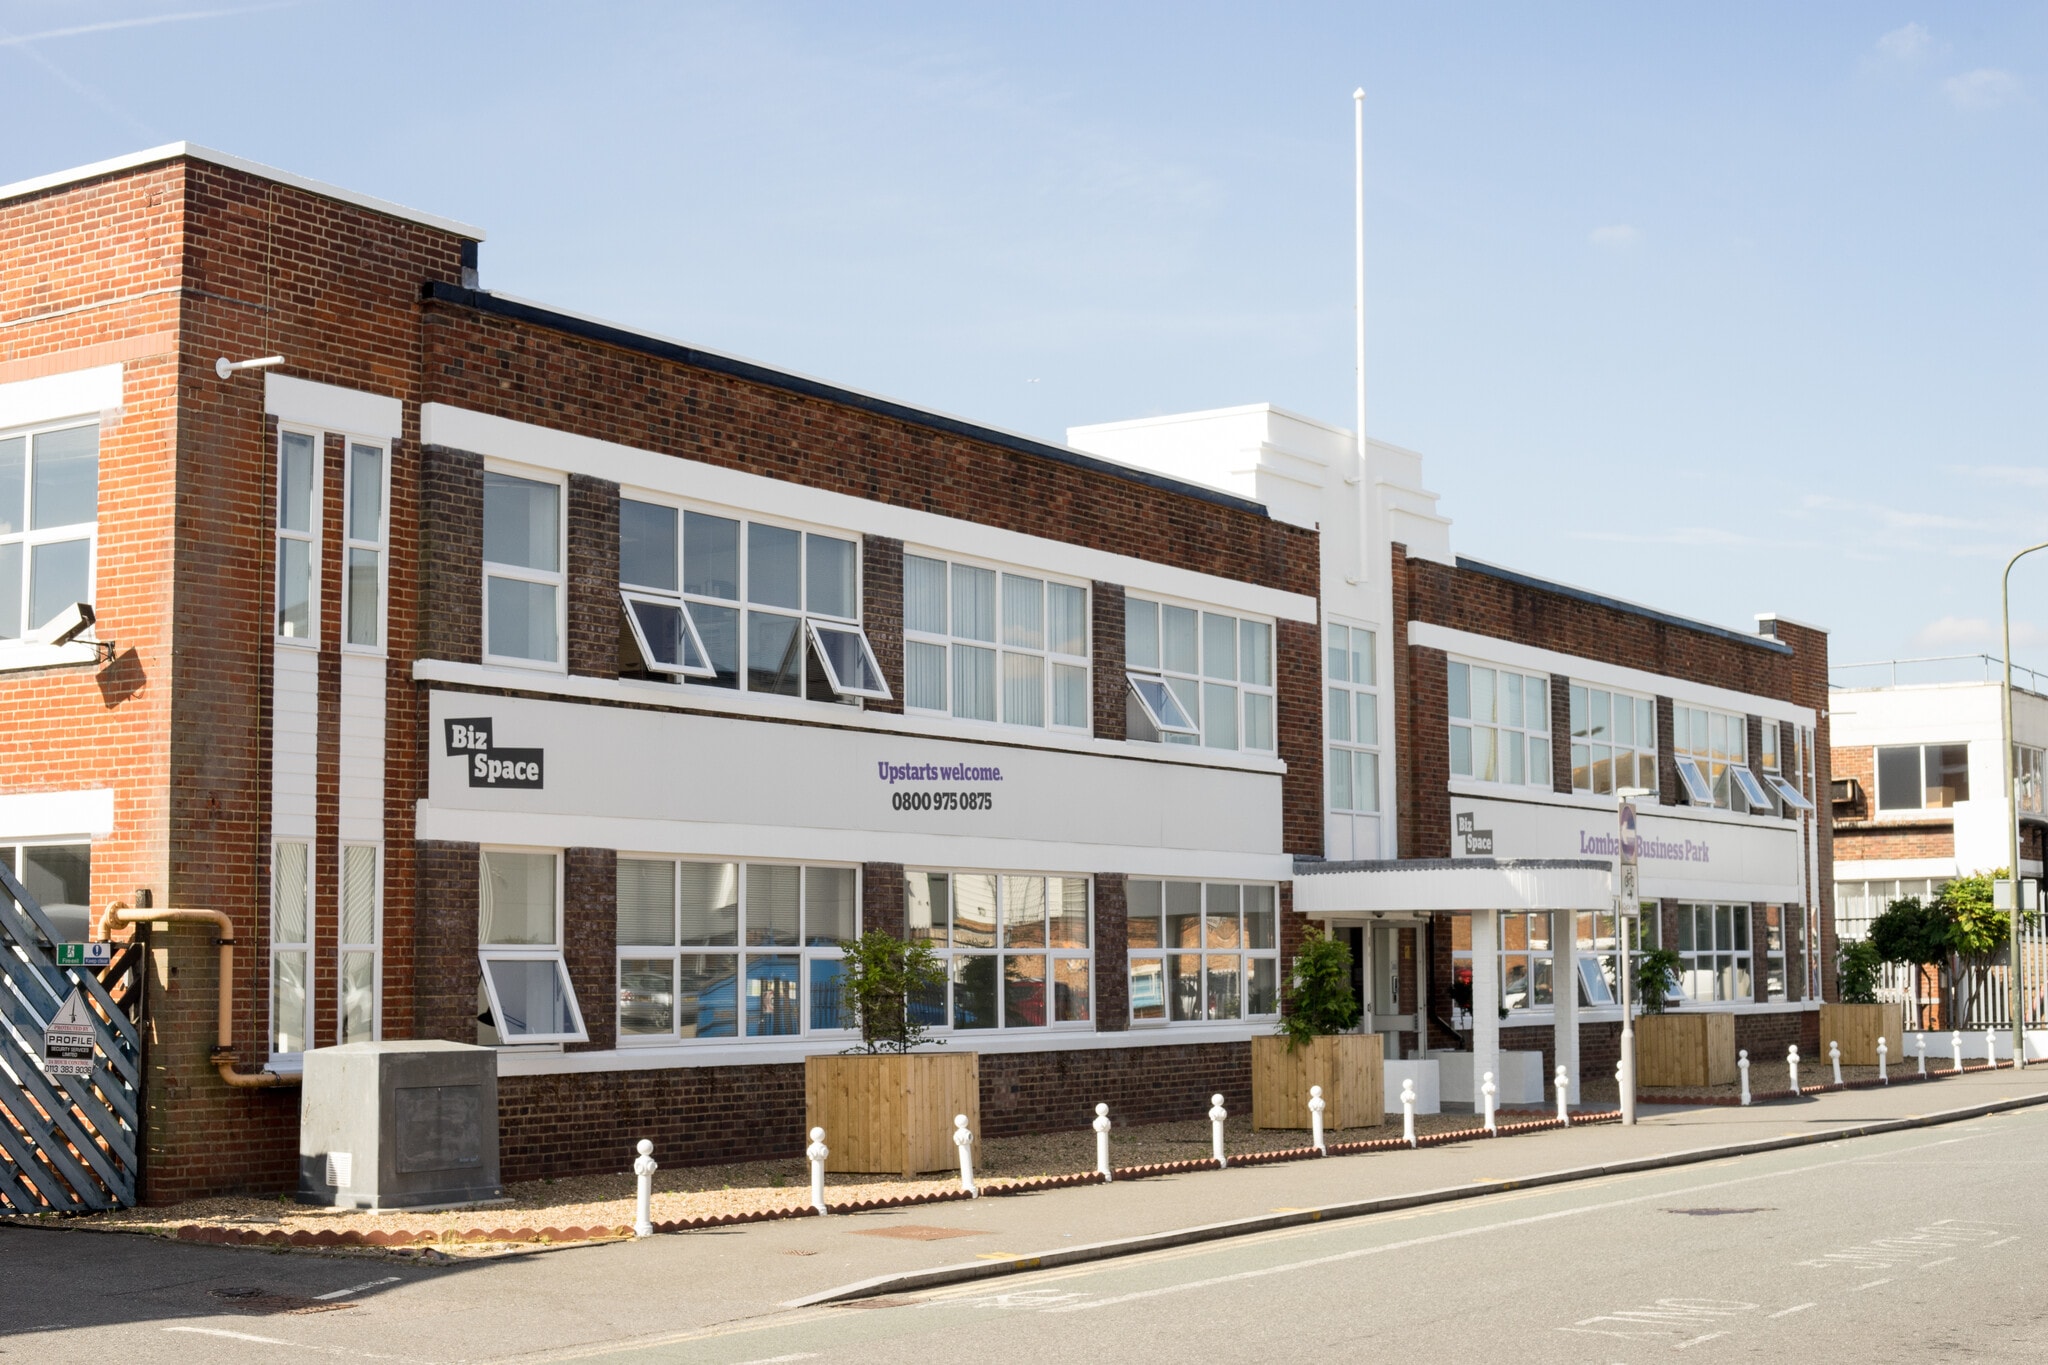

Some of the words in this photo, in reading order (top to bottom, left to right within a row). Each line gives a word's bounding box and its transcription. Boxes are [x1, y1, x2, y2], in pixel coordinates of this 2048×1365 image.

[451, 724, 488, 750] Biz
[474, 753, 540, 784] Space
[878, 761, 939, 785] Upstarts
[939, 762, 1004, 782] welcome.
[891, 792, 932, 812] 0800
[933, 792, 958, 811] 975
[959, 792, 993, 811] 0875
[1458, 816, 1473, 833] Biz
[1467, 833, 1492, 852] Space
[1580, 830, 1620, 857] Lomba
[1636, 834, 1684, 861] Business
[1684, 839, 1710, 863] Park
[85, 957, 97, 965] Keep
[48, 1035, 93, 1045] PROFILE
[45, 1065, 59, 1073] 0113
